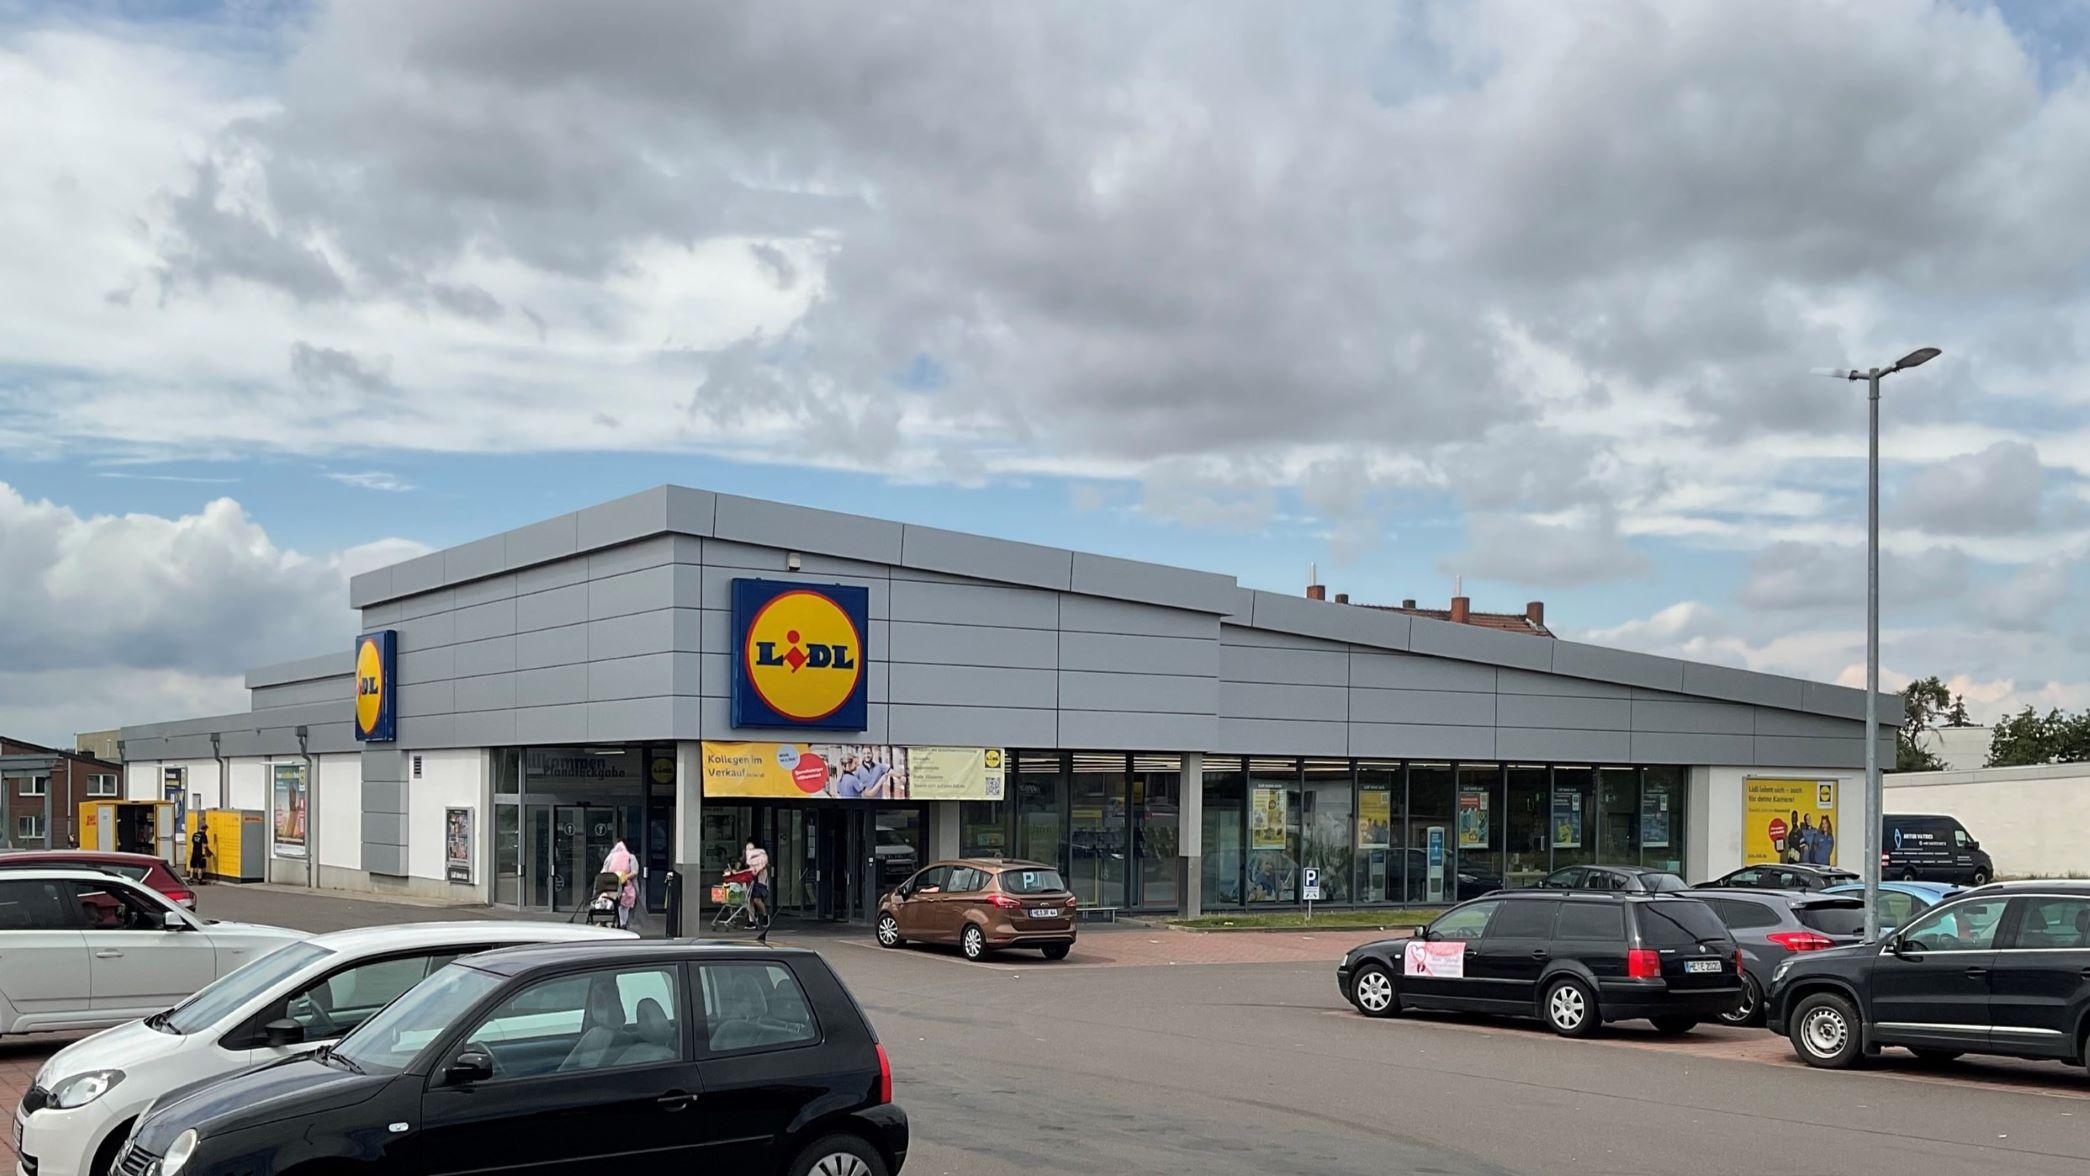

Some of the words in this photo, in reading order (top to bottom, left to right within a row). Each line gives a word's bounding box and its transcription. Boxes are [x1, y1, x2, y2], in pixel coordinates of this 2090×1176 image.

[707, 754, 750, 766] Kollegen
[750, 754, 763, 764] im
[708, 768, 746, 778] Verkauf
[1306, 870, 1316, 886] P
